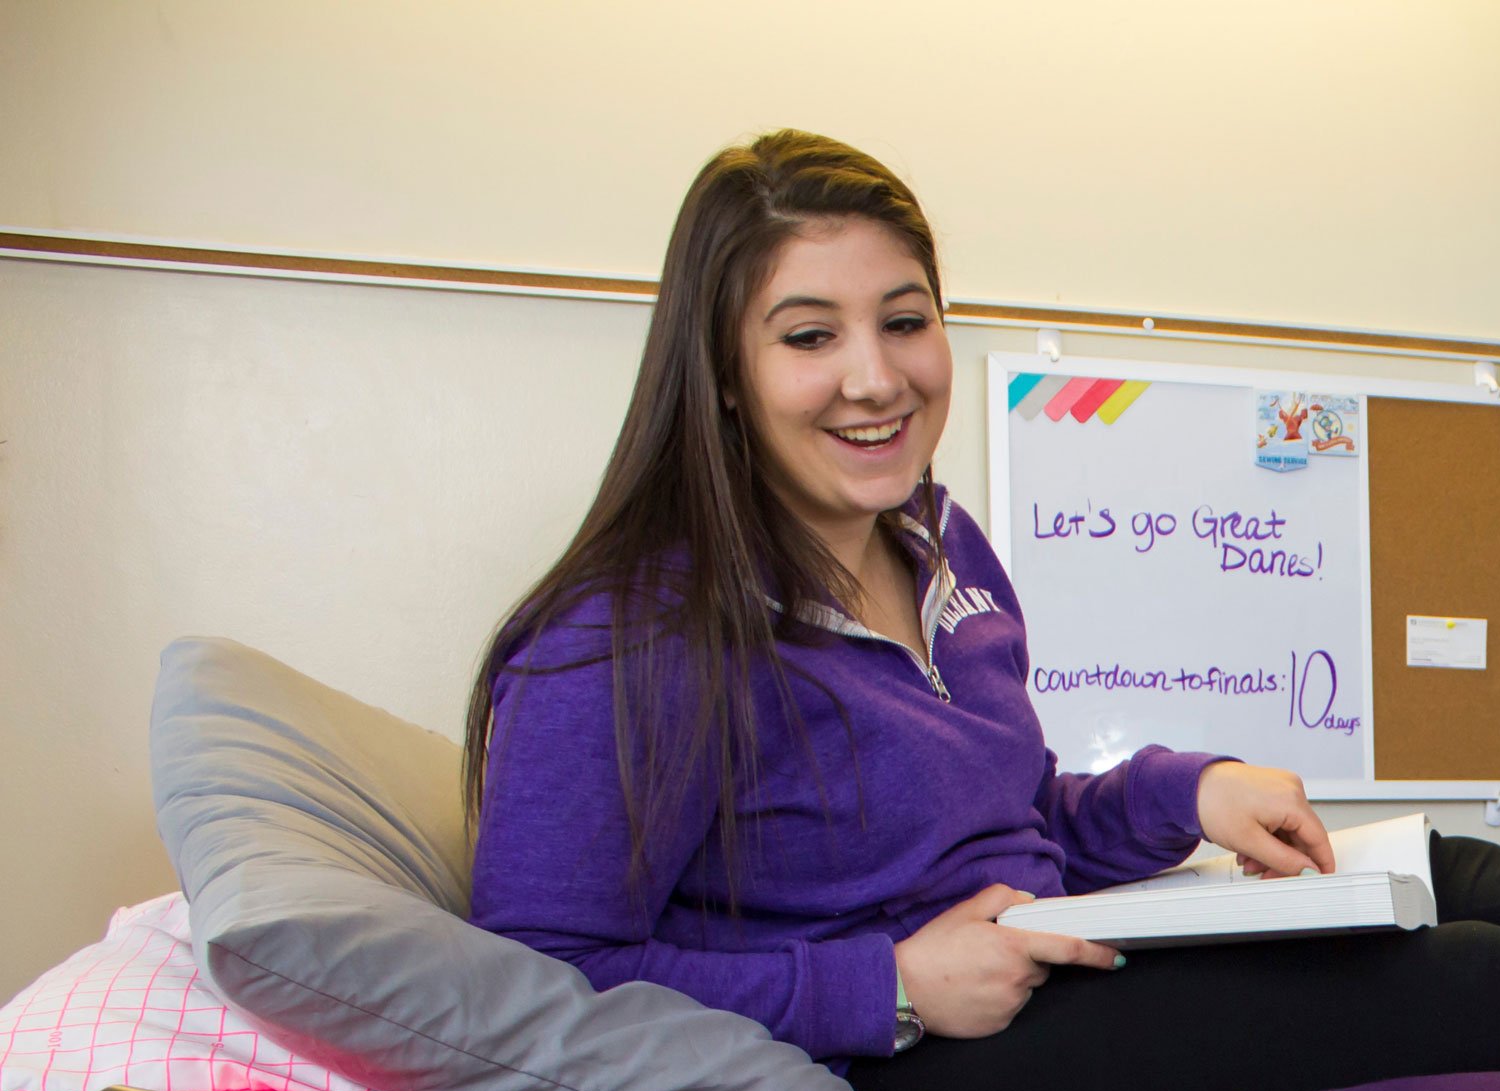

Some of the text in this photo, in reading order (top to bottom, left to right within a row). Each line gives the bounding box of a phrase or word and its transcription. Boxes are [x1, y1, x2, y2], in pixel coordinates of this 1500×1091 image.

[1033, 498, 1286, 553] Let's go Great
[1220, 541, 1323, 581] Danes!
